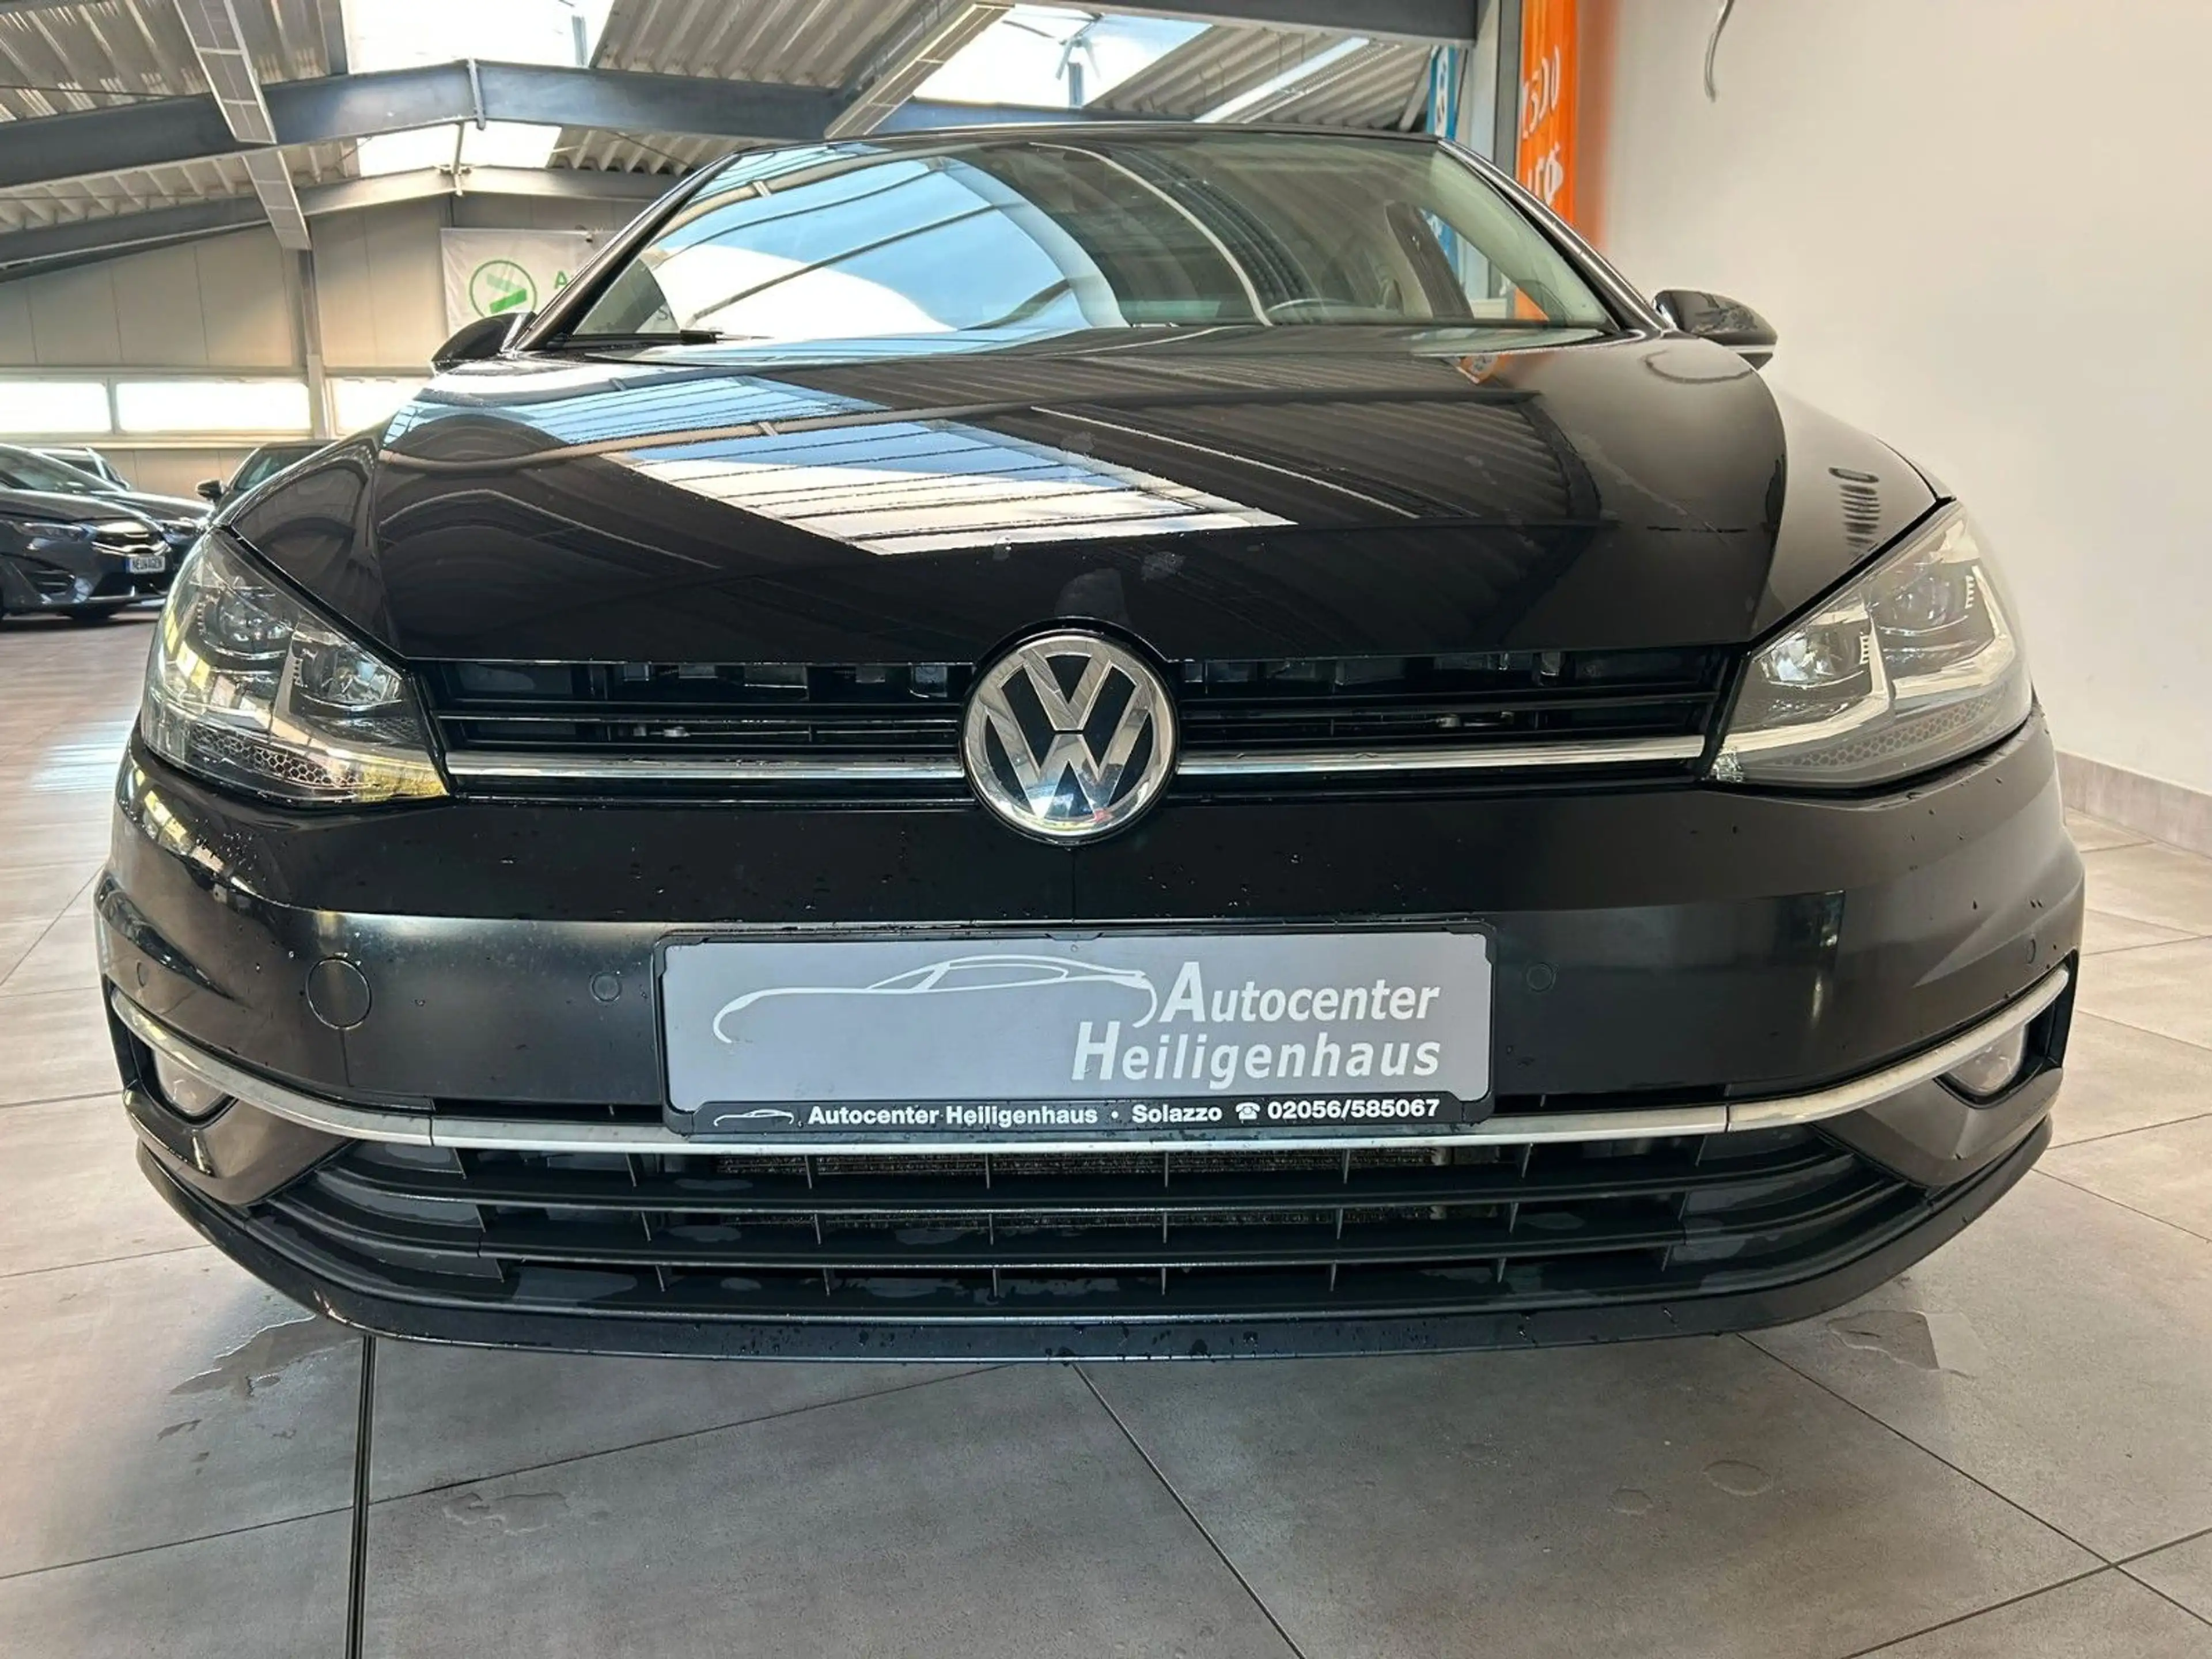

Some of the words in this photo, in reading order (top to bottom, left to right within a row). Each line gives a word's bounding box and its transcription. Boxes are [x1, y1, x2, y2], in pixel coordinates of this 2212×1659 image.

[978, 642, 1156, 823] VW
[1158, 961, 1441, 1023] Autocenter
[1071, 1020, 1441, 1090] Heiligenhaus
[808, 1105, 940, 1124] Autocenter
[946, 1105, 1099, 1128] Heiligenhaus
[1131, 1104, 1222, 1123] Solazzo
[1267, 1099, 1440, 1120] 02056/585067
